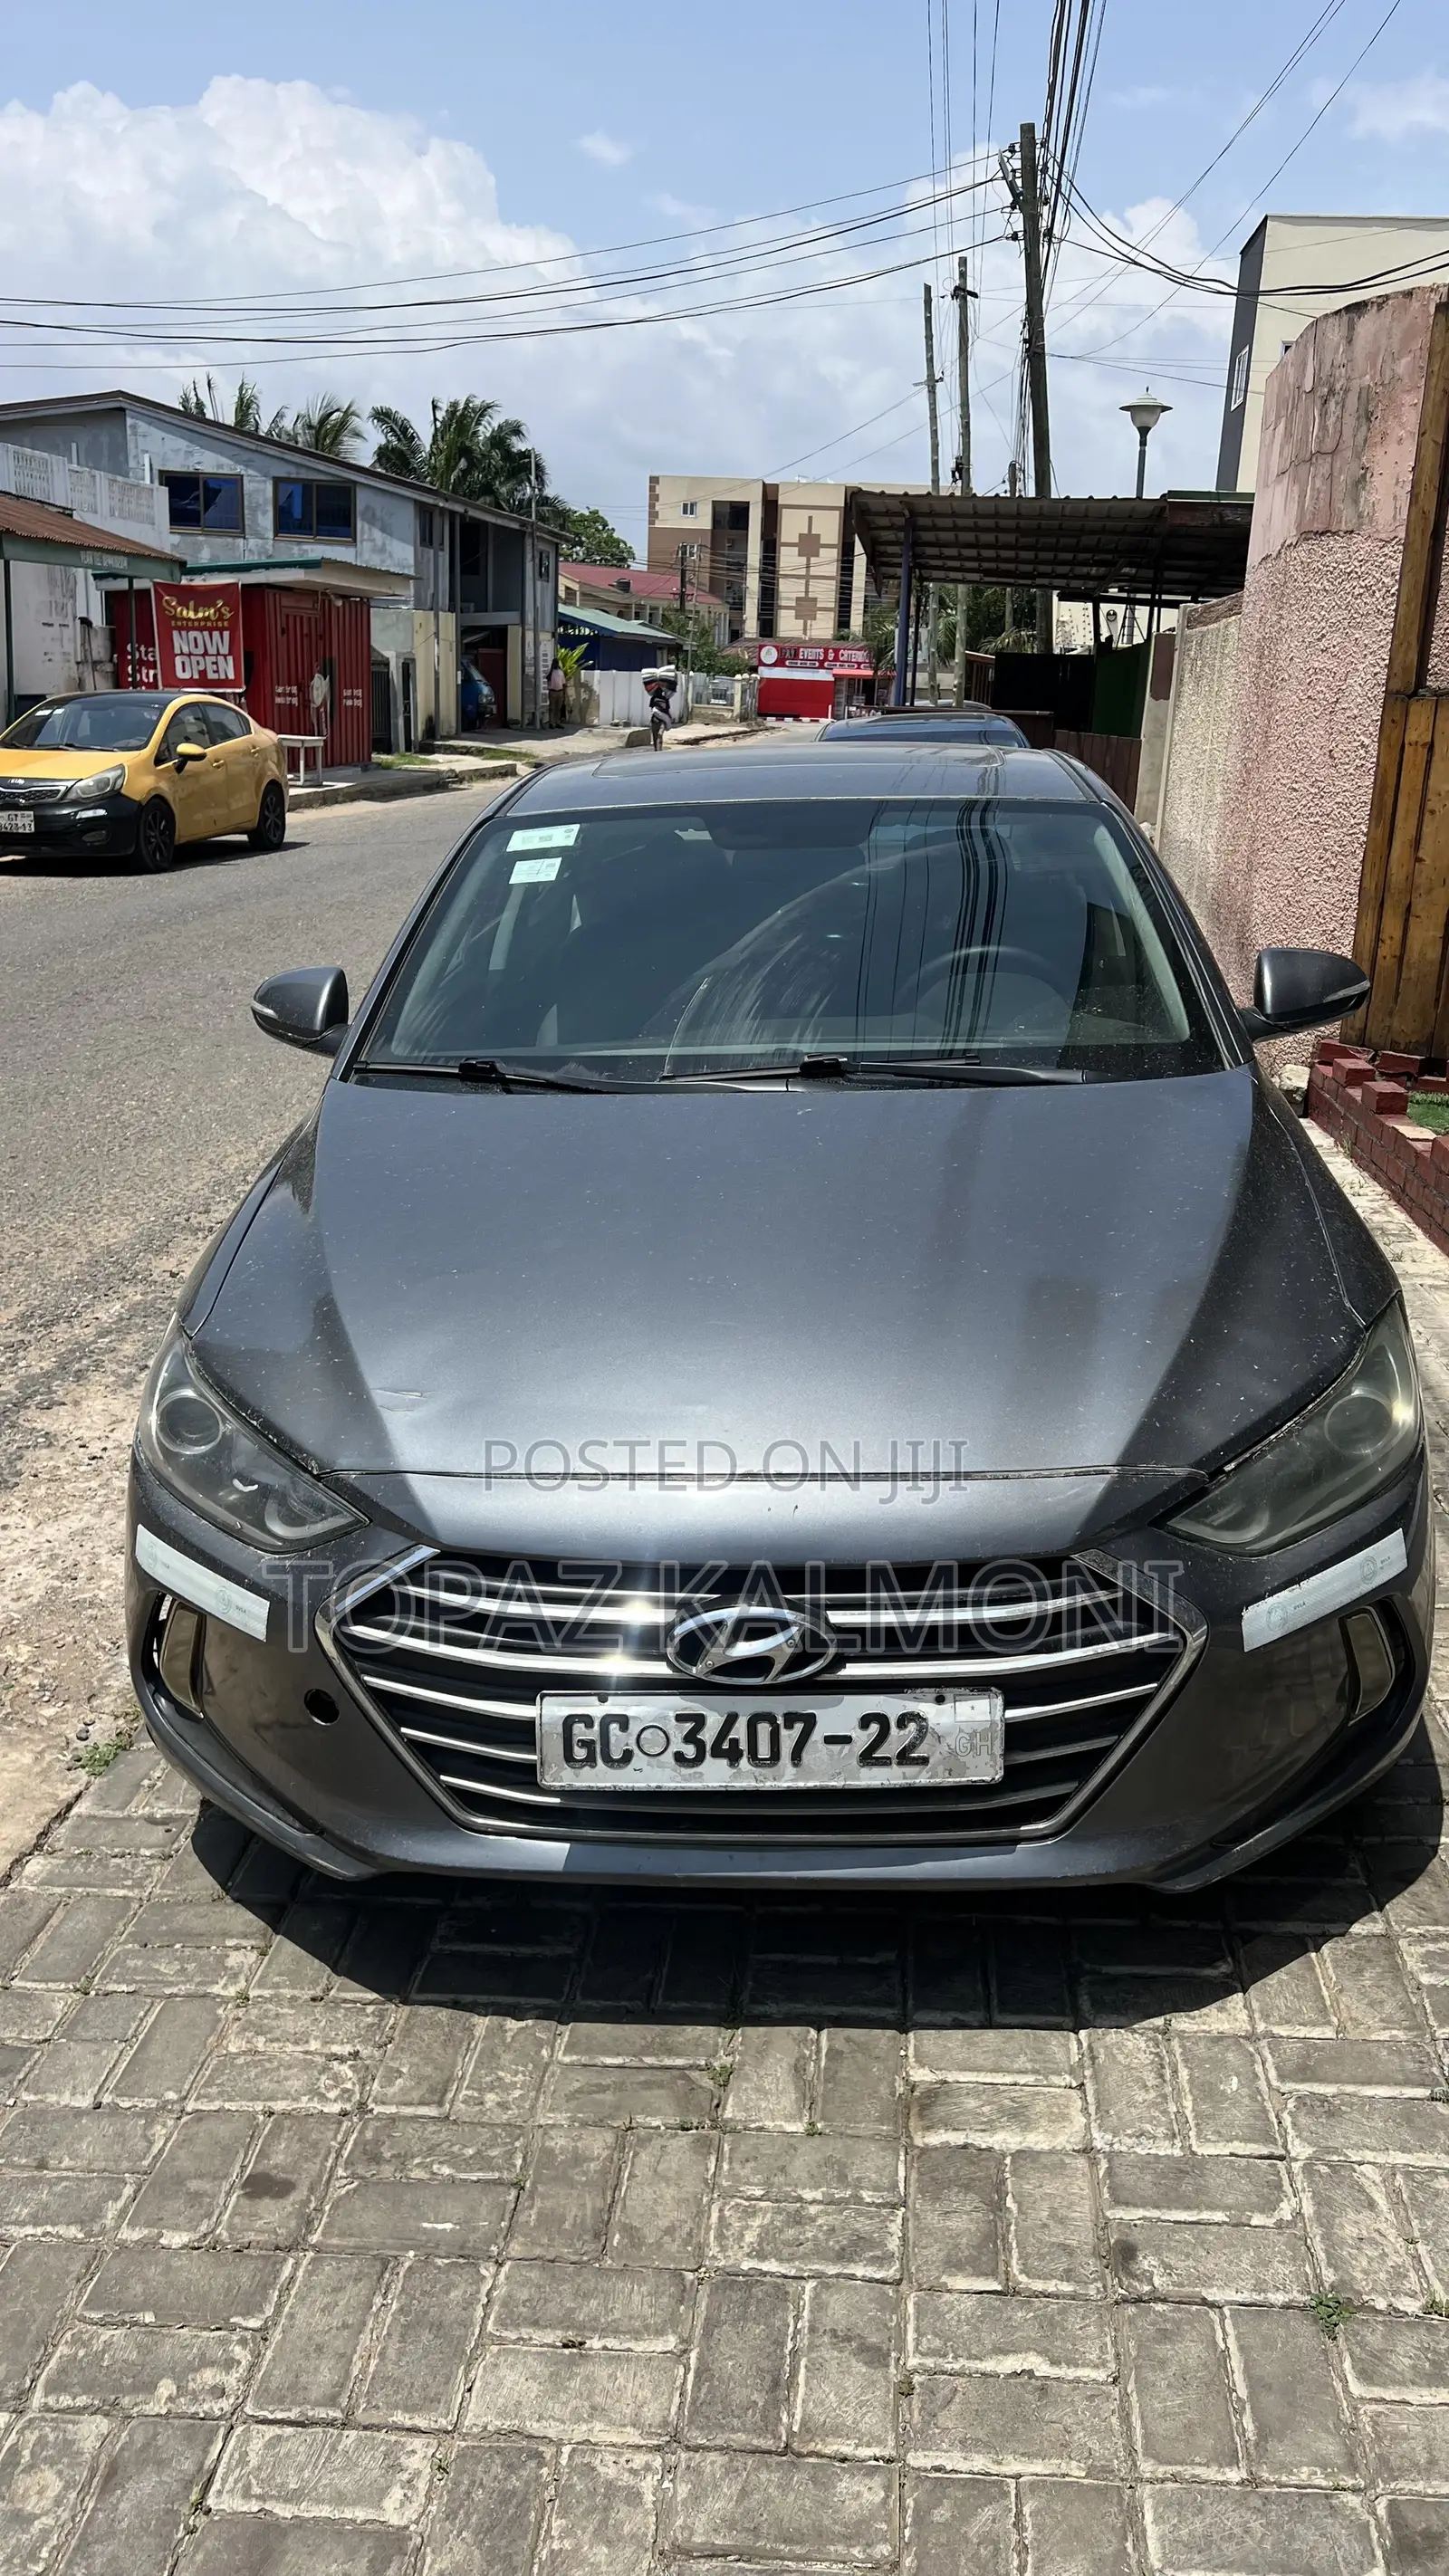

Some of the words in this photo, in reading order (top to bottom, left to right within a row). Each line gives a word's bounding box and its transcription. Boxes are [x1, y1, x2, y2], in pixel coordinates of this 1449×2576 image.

[163, 596, 235, 620] Salm's
[127, 643, 157, 661] Sta
[172, 630, 230, 655] NOW
[799, 647, 825, 660] EVENTS
[828, 648, 835, 661] &
[128, 665, 158, 683] Str
[175, 656, 235, 680] OPEN
[561, 1713, 633, 1768] GC
[673, 1709, 931, 1768] 3407-22
[954, 1729, 993, 1757] GH
